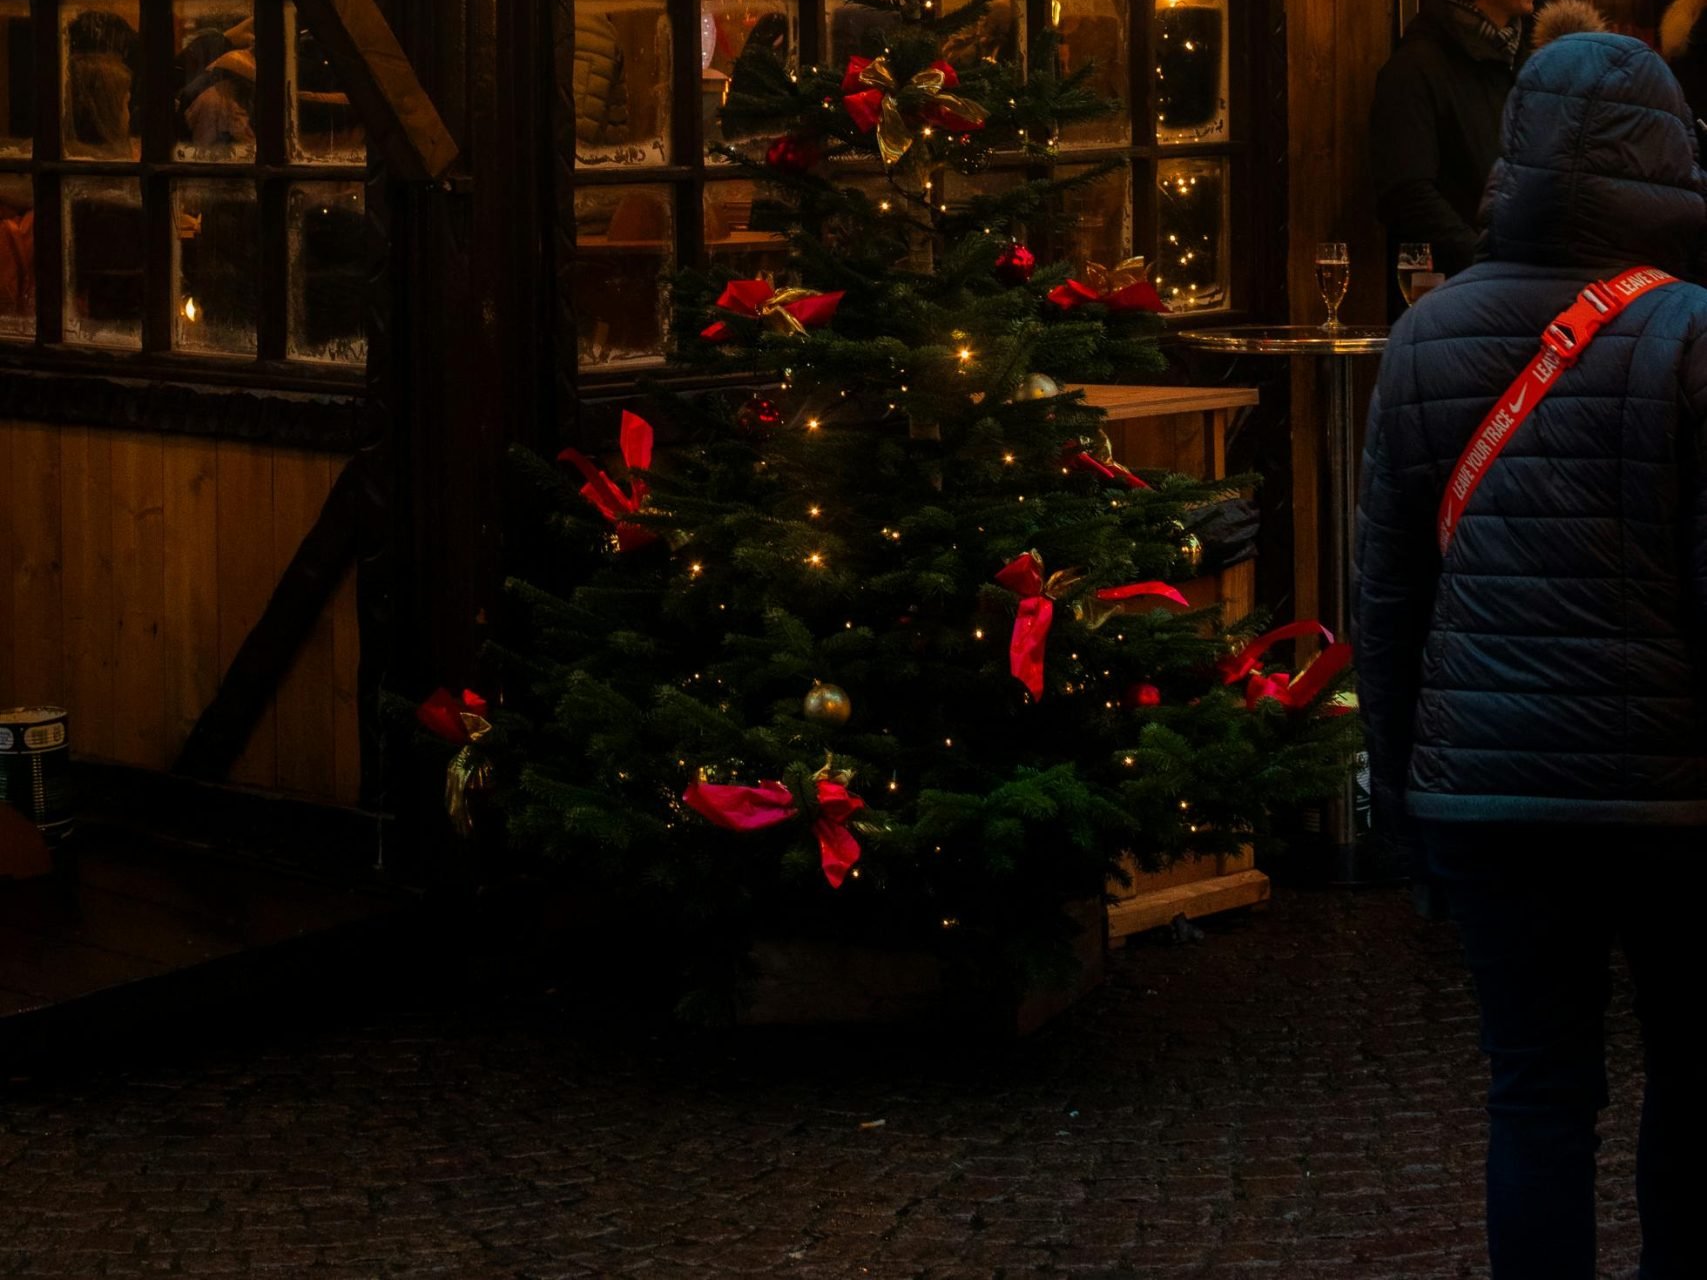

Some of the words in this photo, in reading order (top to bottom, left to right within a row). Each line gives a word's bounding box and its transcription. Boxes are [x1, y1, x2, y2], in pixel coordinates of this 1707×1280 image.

[1615, 271, 1653, 296] LEAVE
[1453, 464, 1475, 500] LEAVE
[1466, 440, 1492, 472] YOUR
[1482, 409, 1514, 445] TRACE
